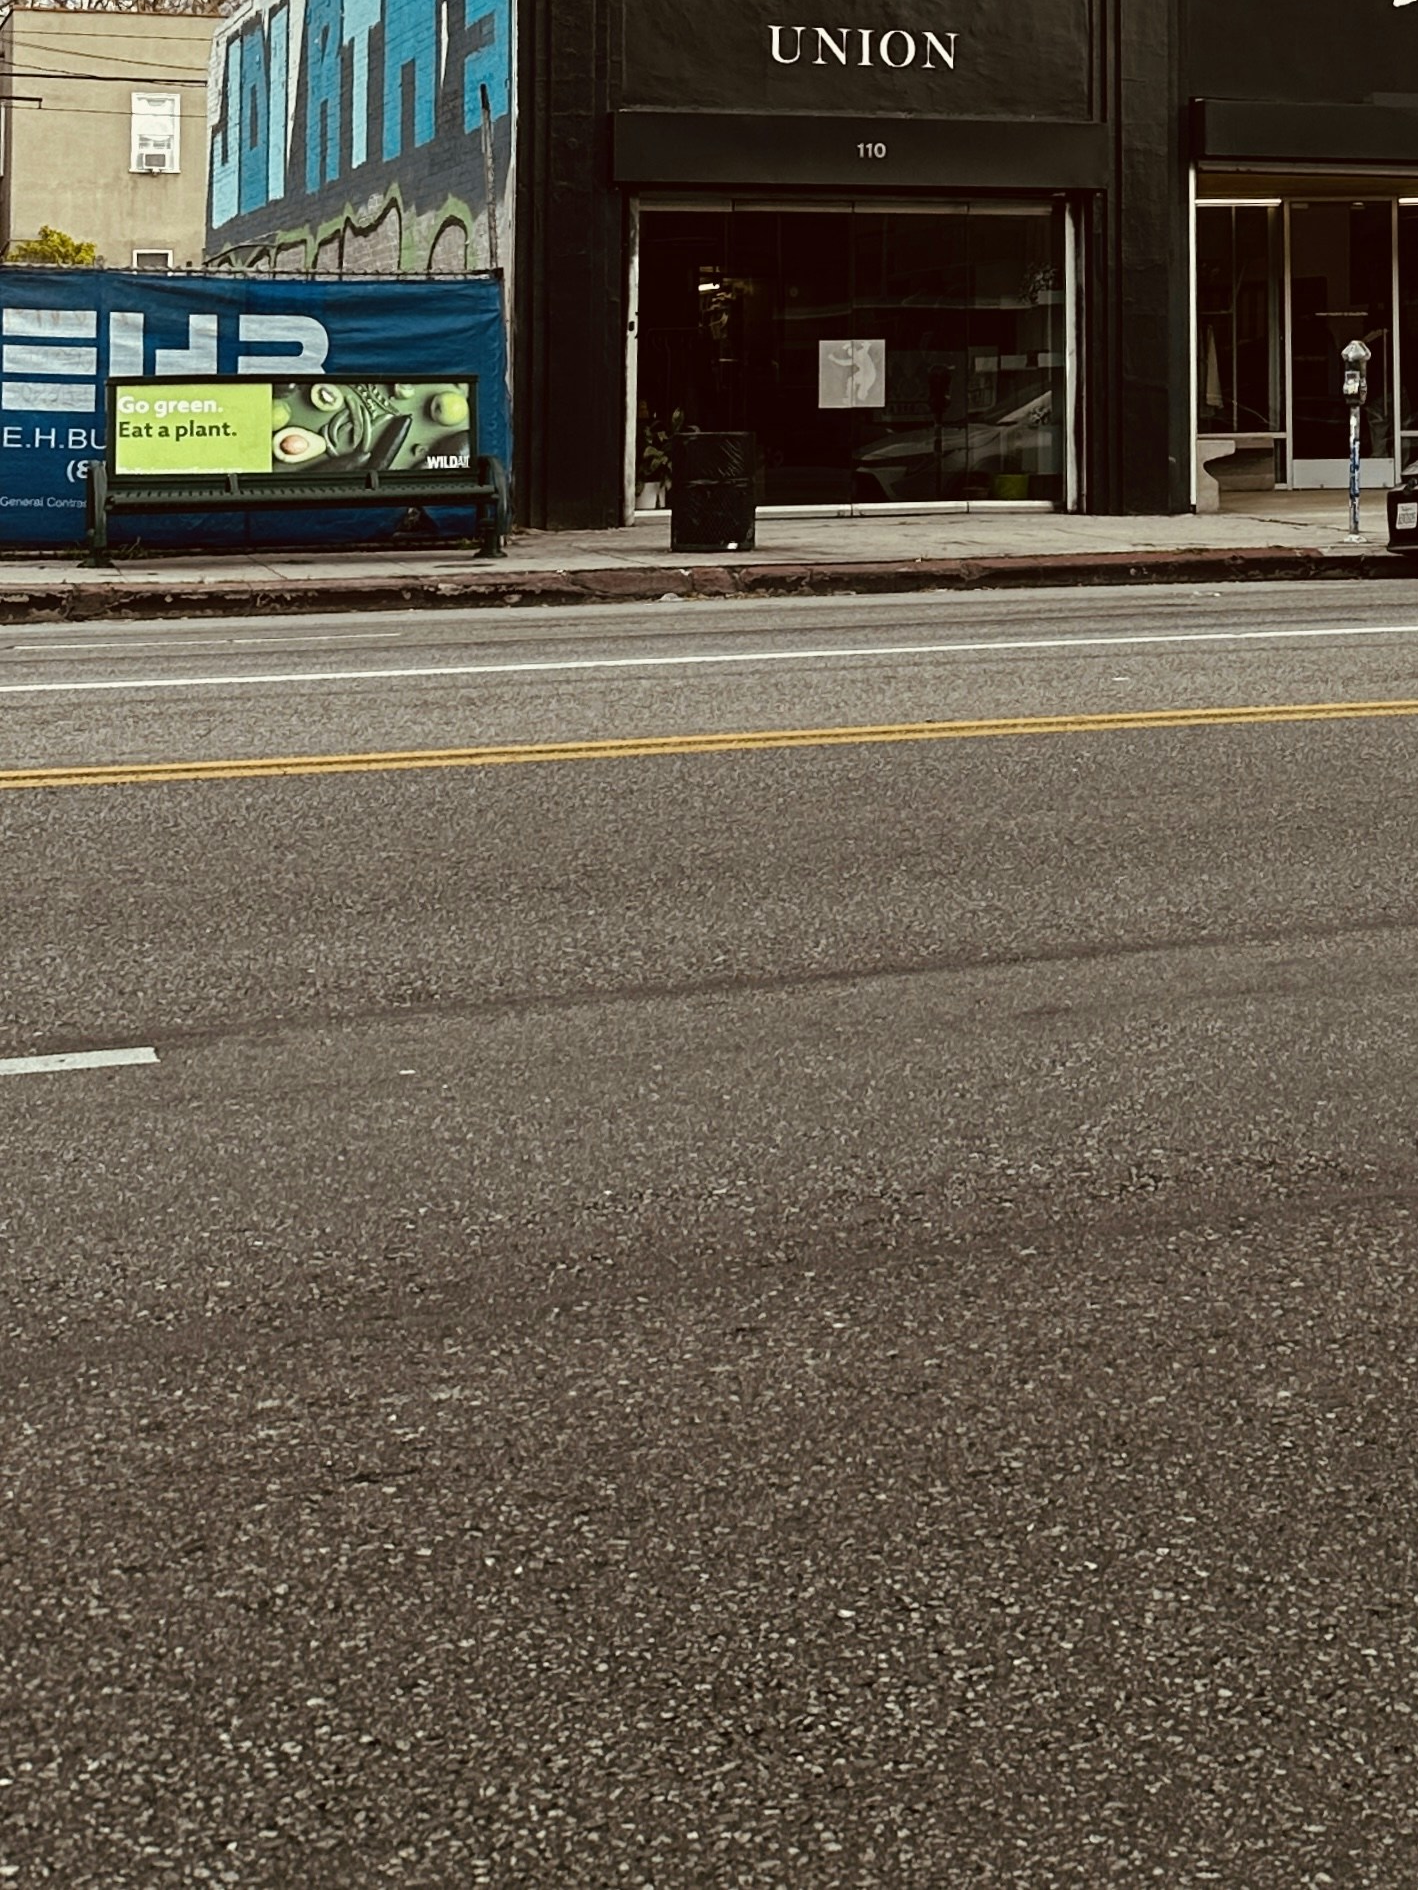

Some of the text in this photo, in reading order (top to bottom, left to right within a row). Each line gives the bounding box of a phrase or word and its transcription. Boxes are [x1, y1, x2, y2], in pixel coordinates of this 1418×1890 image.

[767, 24, 960, 70] UNION
[857, 142, 887, 159] 110
[117, 395, 224, 418] Go green.
[119, 419, 238, 442] Eat a plant.
